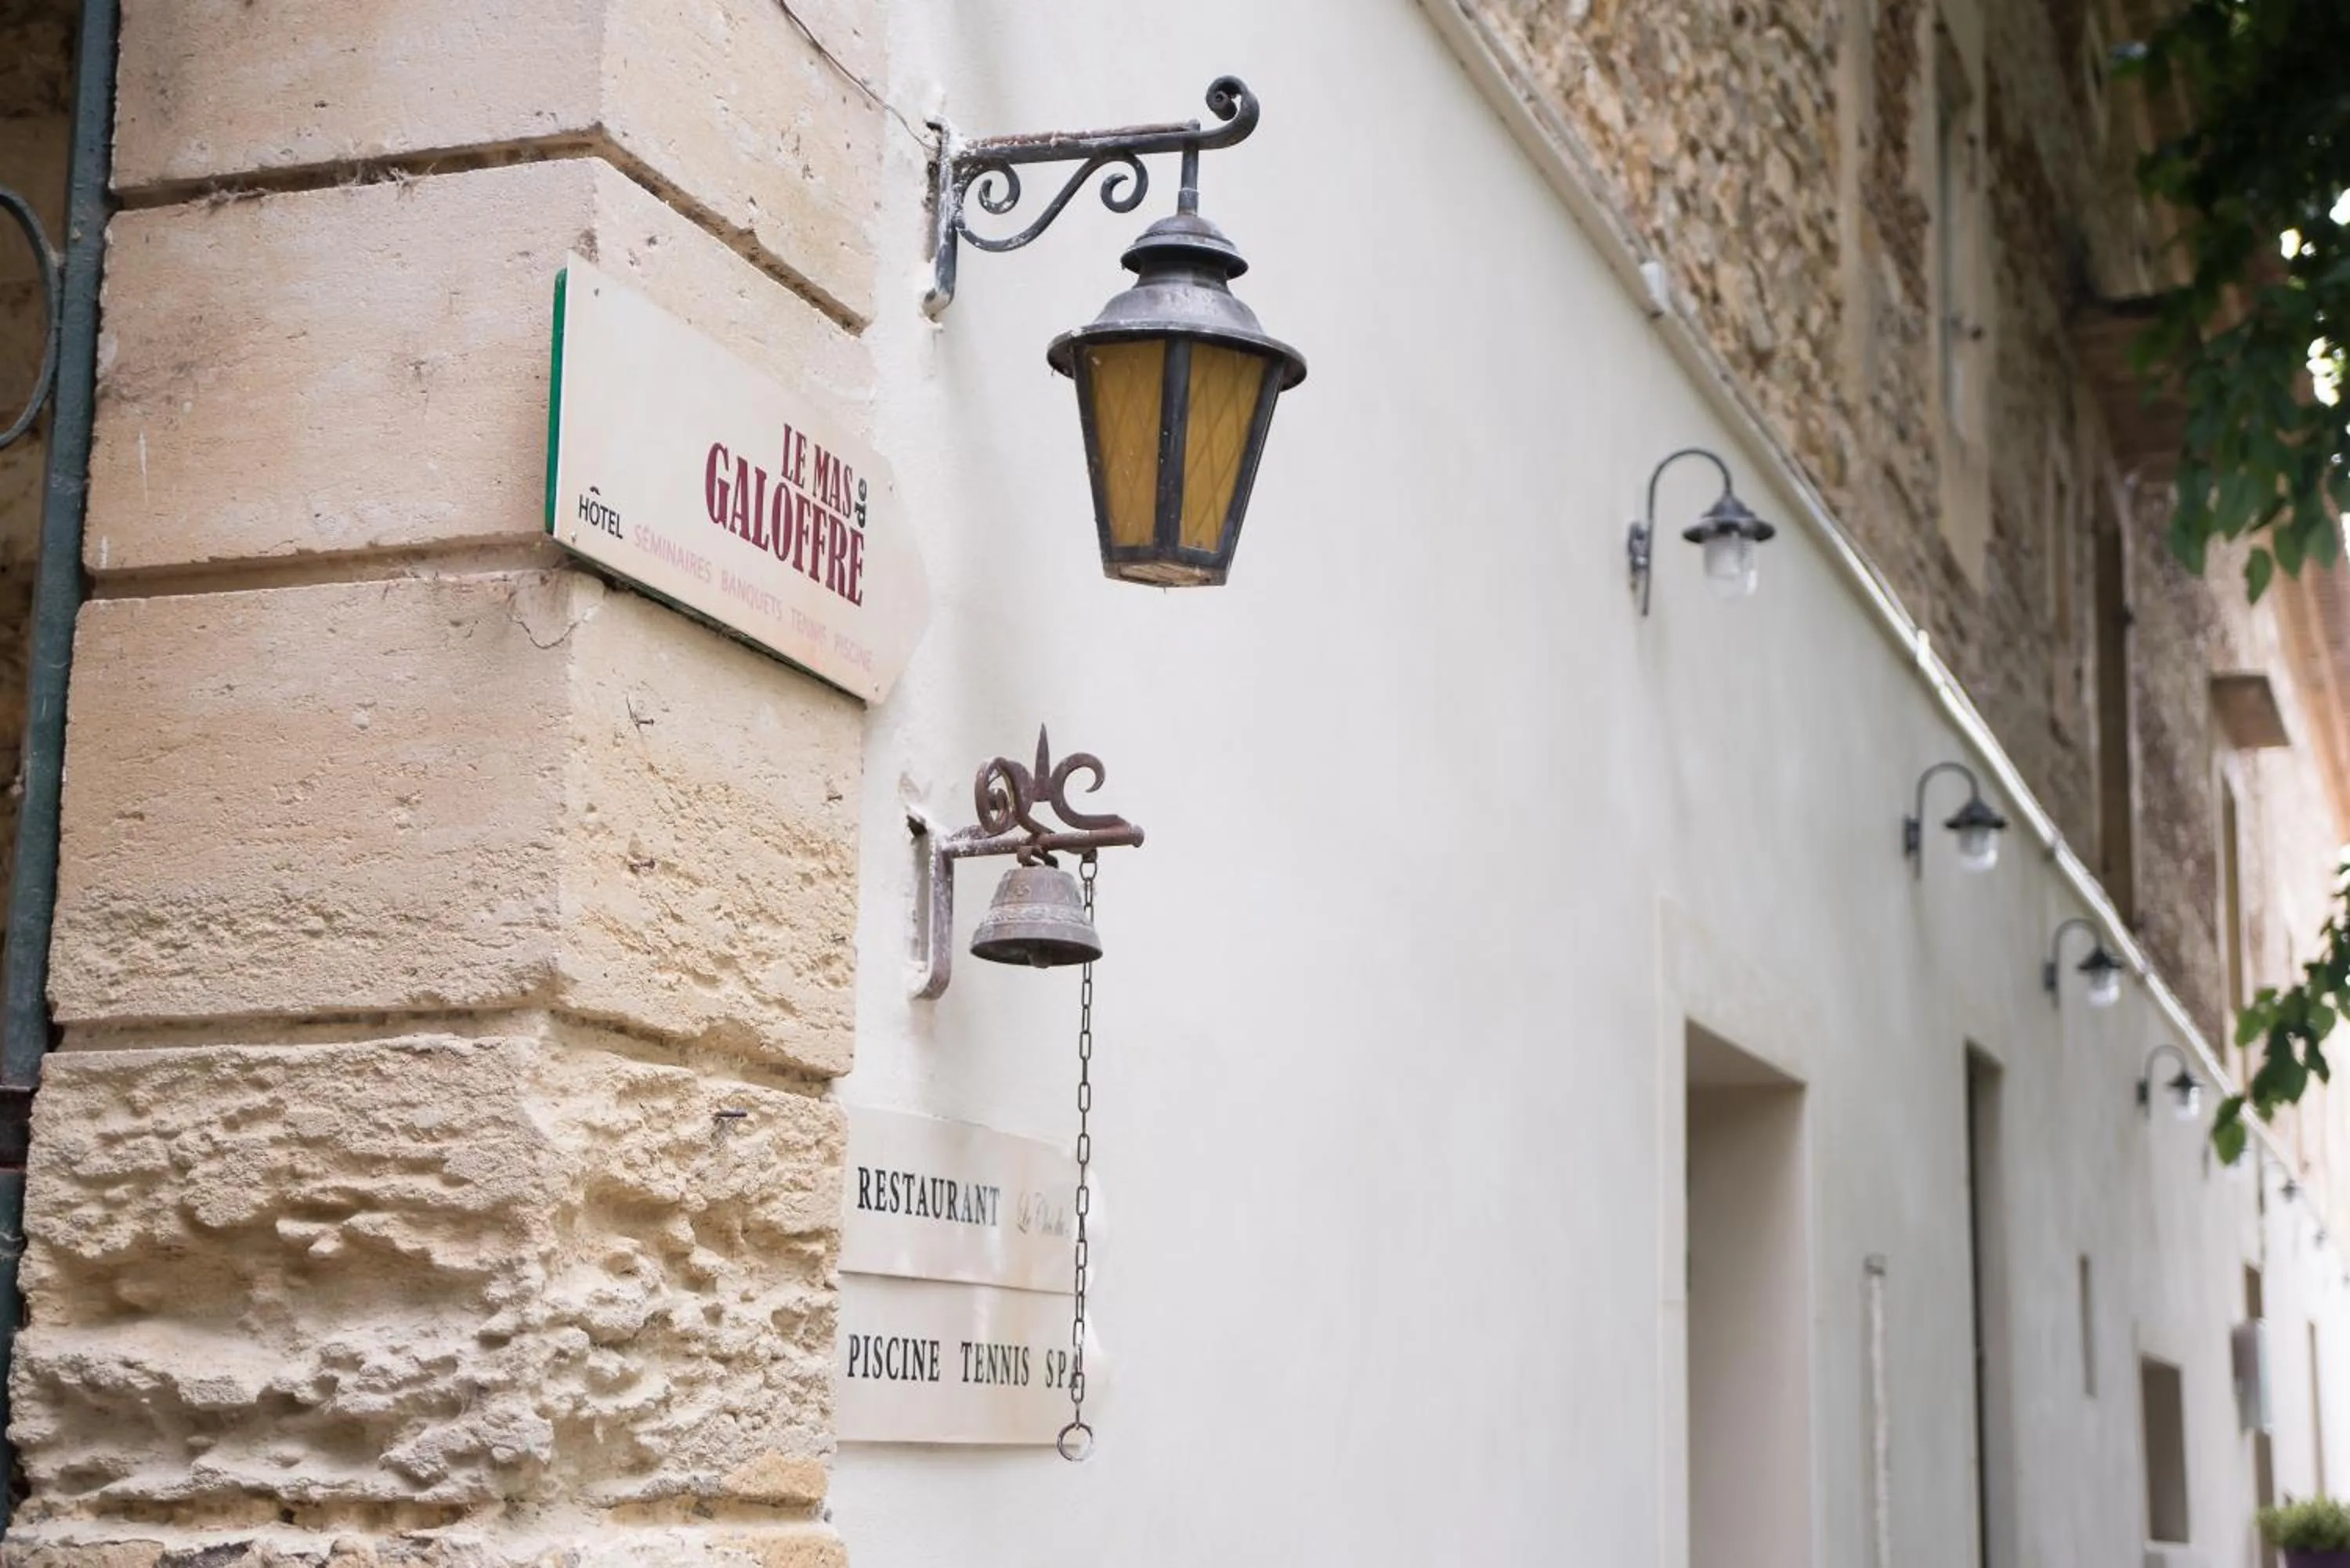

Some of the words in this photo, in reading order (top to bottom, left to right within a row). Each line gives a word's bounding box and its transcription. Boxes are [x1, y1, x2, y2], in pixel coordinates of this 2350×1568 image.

[781, 423, 808, 490] LE
[812, 443, 853, 519] MAS
[855, 477, 867, 529] de
[704, 442, 865, 607] GALOFFRE
[578, 485, 624, 540] HÔTEL
[720, 569, 783, 622] BANQUETS
[790, 606, 827, 645] TEN
[856, 1166, 1001, 1227] RESTAURANT
[847, 1334, 940, 1382] PISCINE
[960, 1341, 1031, 1386] TENNIS
